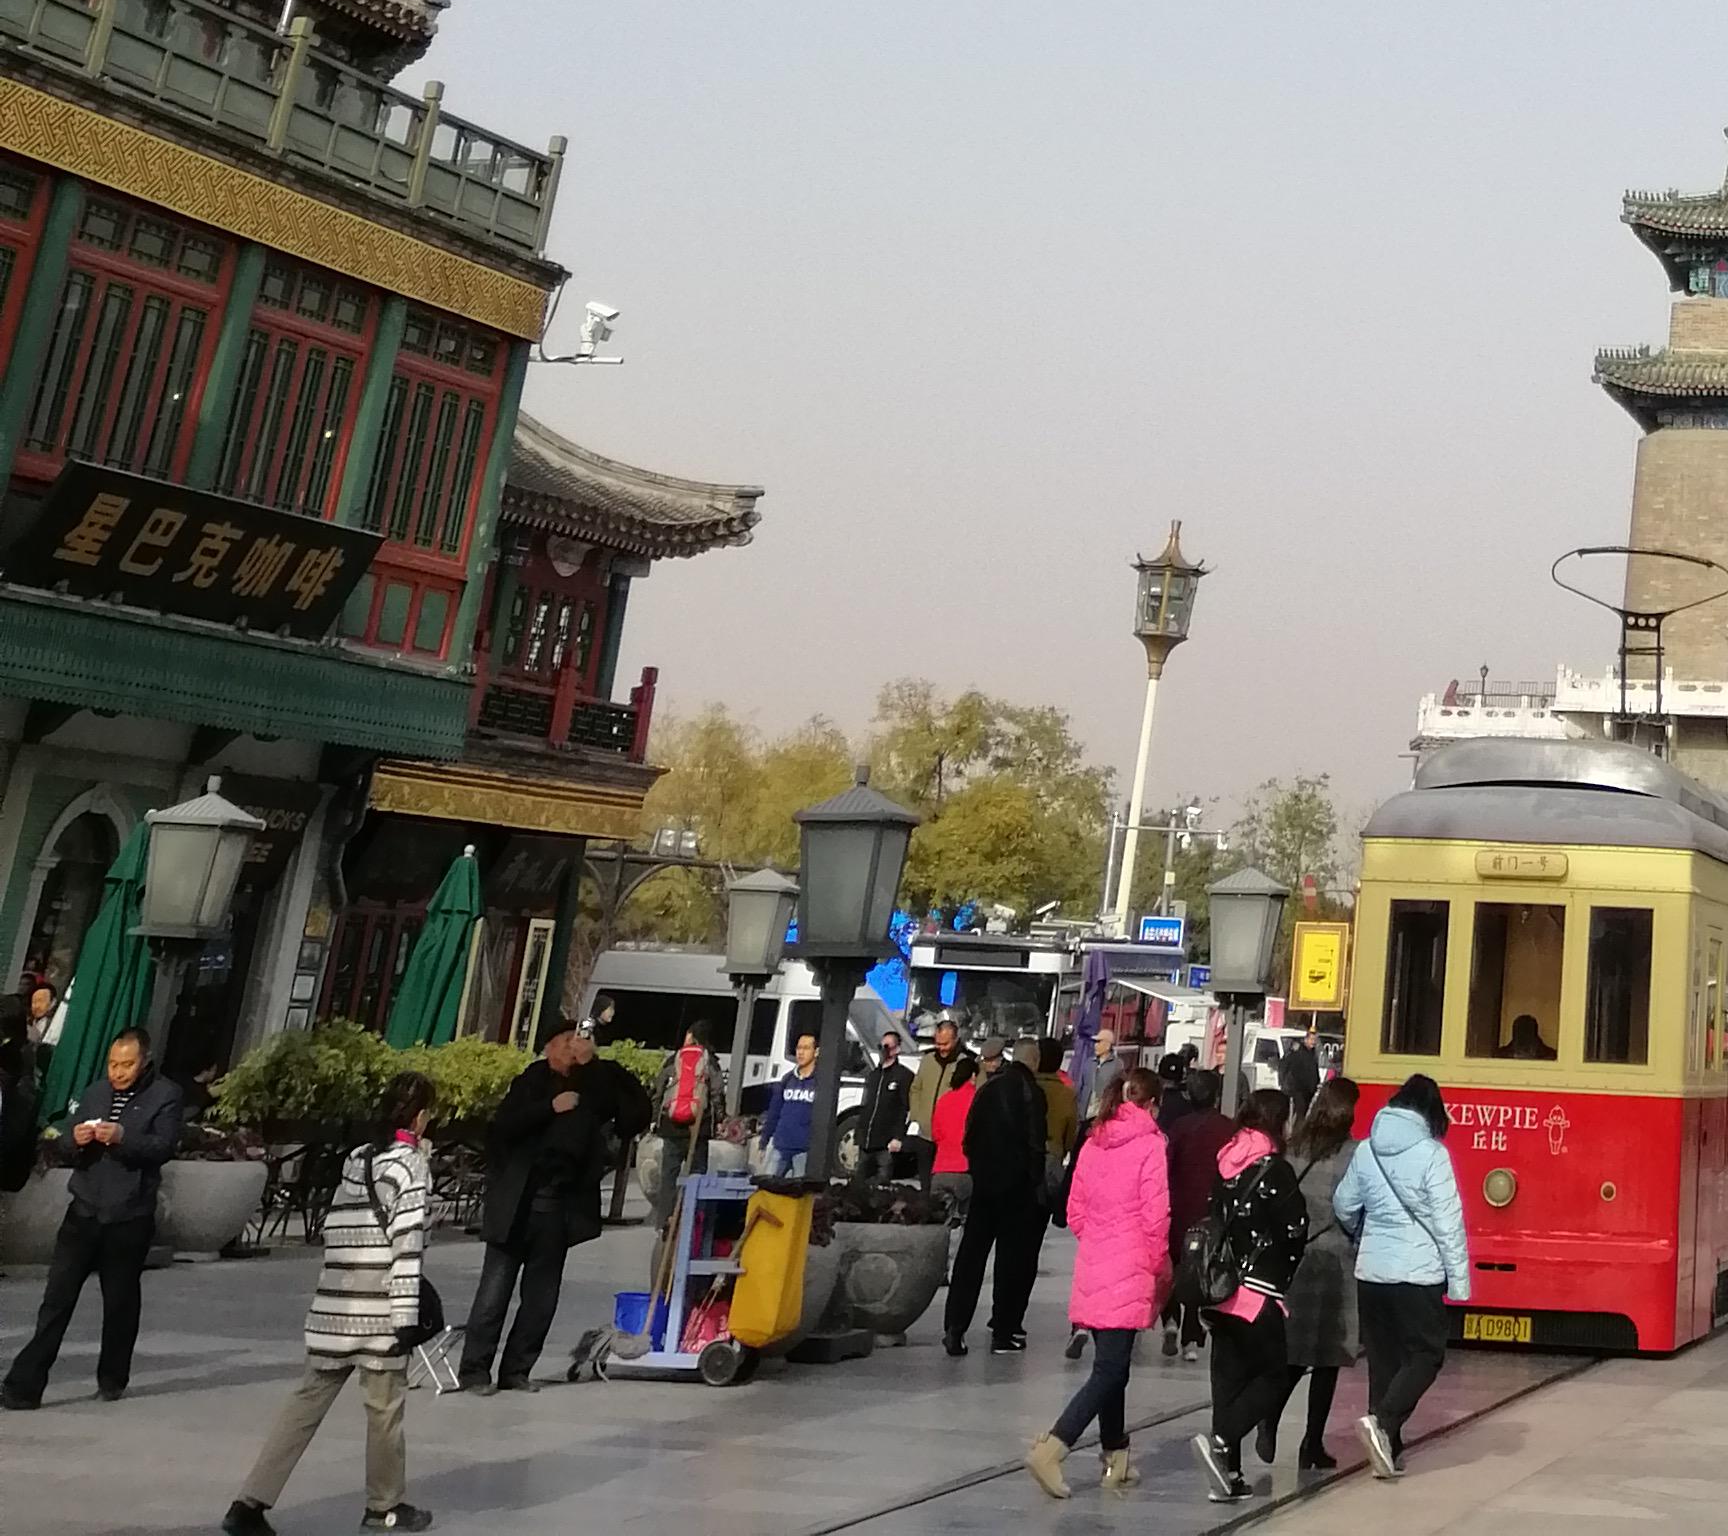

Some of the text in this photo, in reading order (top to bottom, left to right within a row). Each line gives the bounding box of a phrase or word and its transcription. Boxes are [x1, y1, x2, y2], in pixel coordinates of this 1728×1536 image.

[52, 492, 346, 611] 星巴克咖啡
[1492, 854, 1550, 872] 前门一号
[1443, 1102, 1539, 1130] KEWPIE
[1471, 1129, 1508, 1152] 丘比
